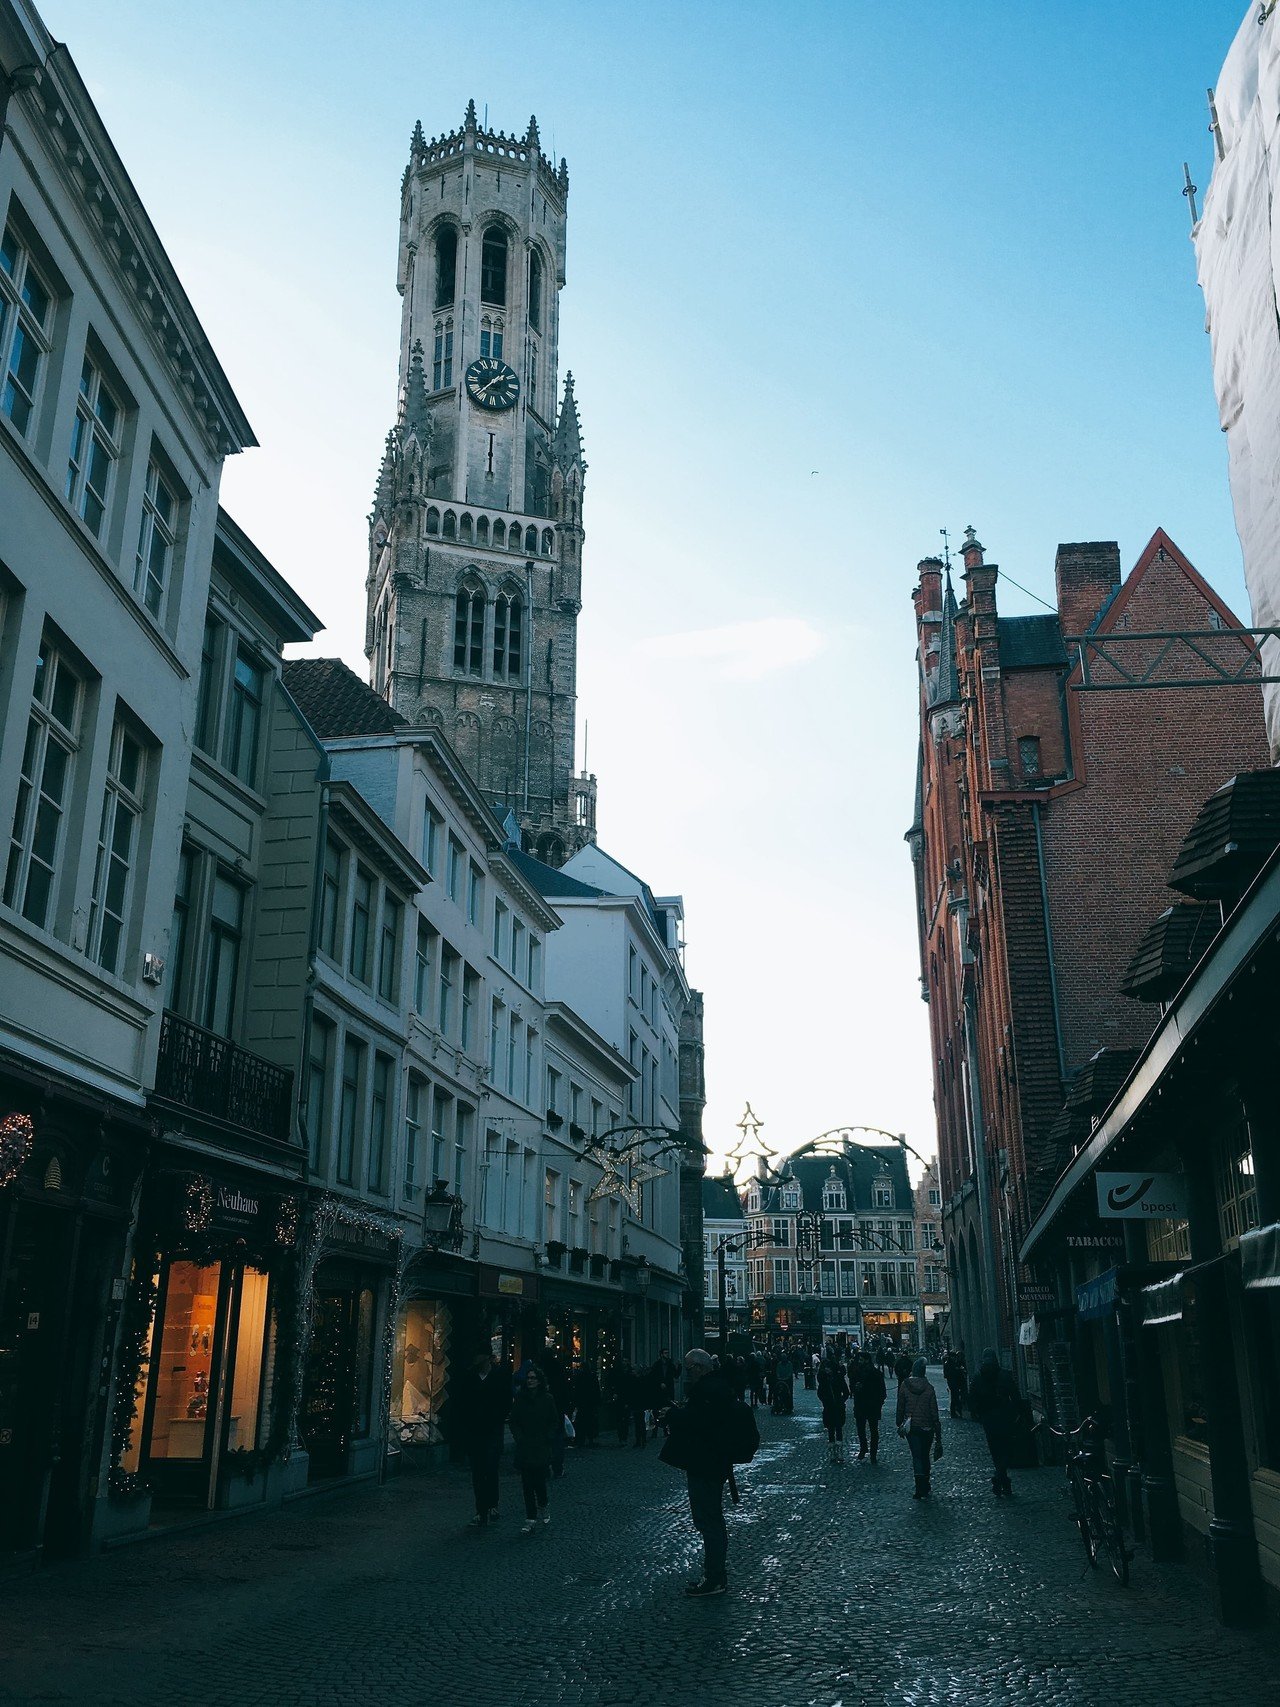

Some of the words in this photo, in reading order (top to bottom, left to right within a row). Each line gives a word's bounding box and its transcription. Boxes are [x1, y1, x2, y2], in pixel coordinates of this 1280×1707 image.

[217, 1187, 259, 1215] Neuhaus
[1141, 1201, 1178, 1214] bpost
[1066, 1236, 1123, 1247] TABACCO
